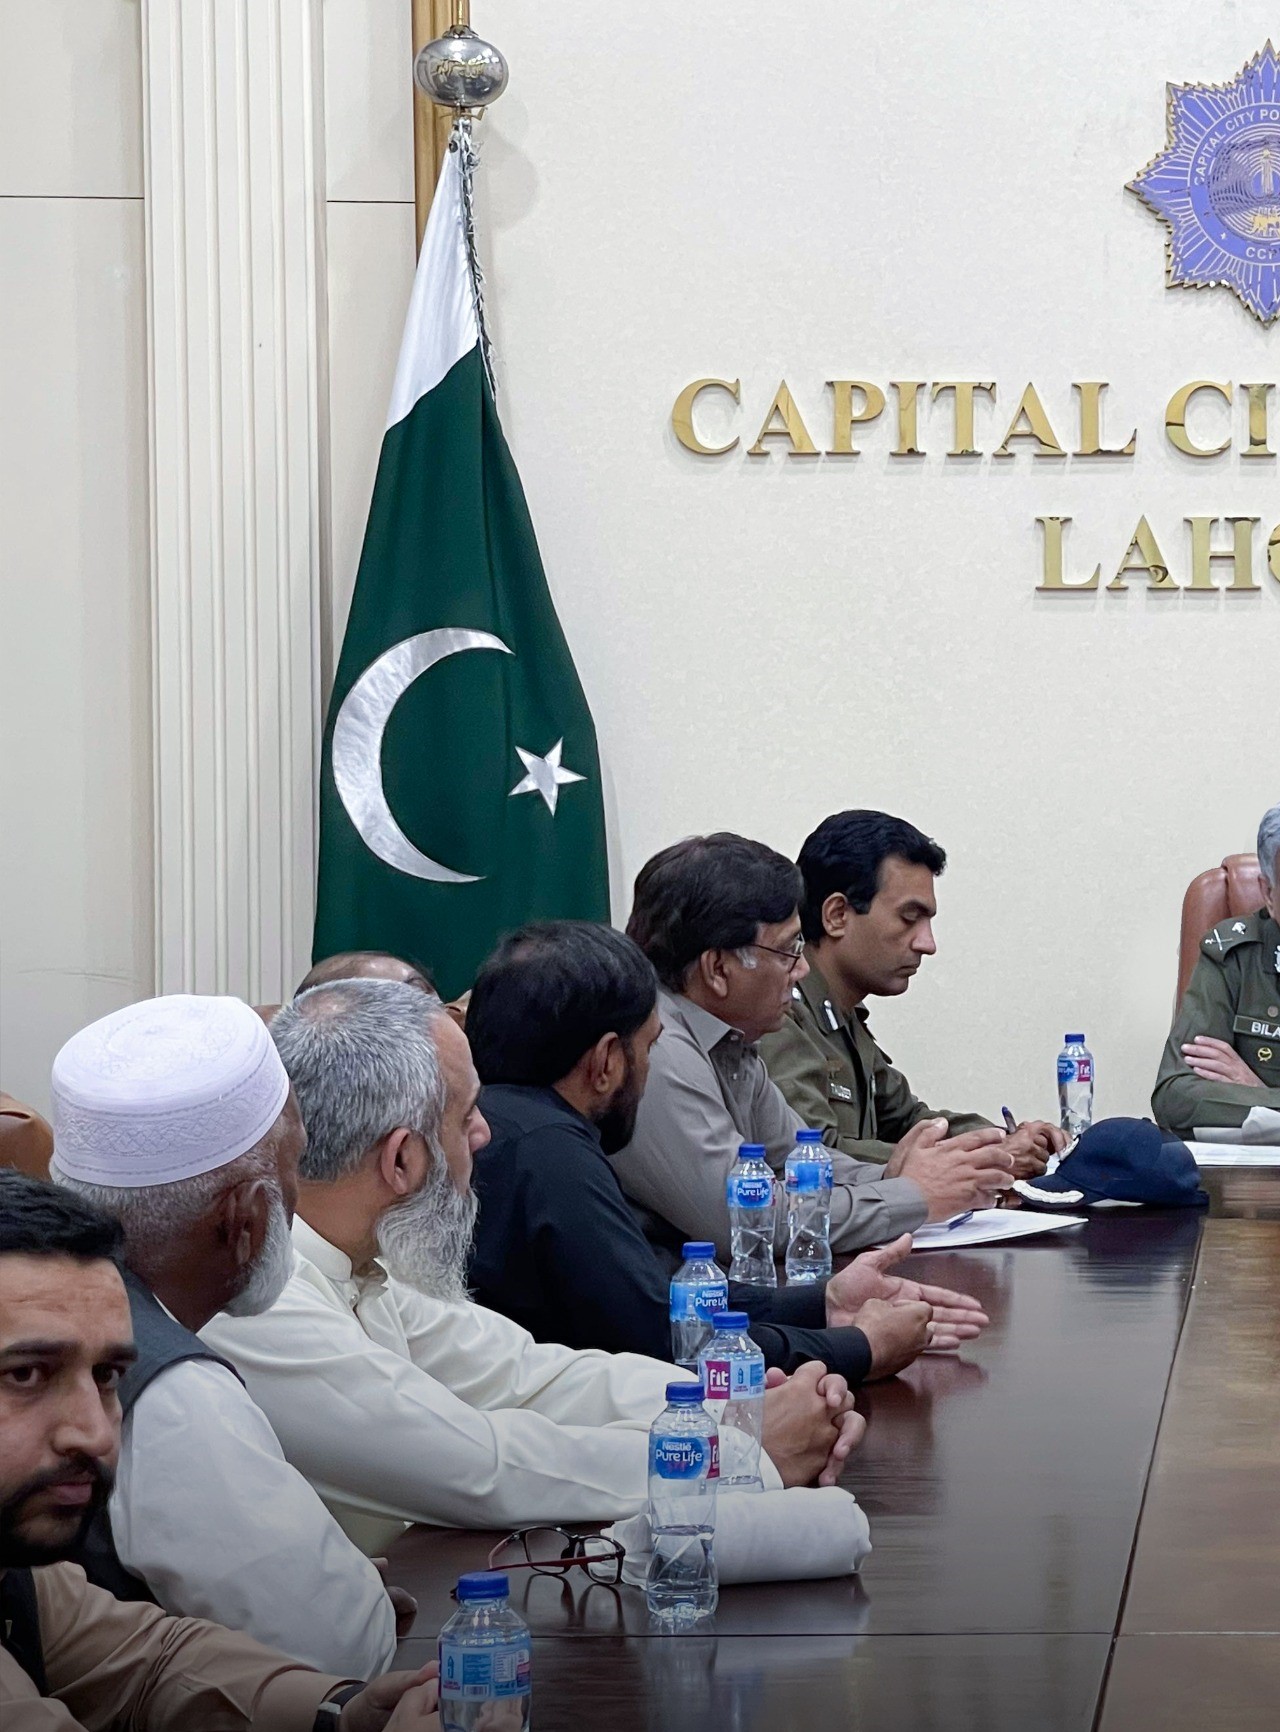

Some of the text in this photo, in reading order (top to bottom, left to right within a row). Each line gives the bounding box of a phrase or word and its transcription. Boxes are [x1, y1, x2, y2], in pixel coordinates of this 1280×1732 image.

[1194, 129, 1226, 186] CAPITAL
[1225, 110, 1255, 132] CITY
[671, 378, 1137, 456] CAPITAL
[737, 1188, 770, 1199] Pure Life
[695, 1297, 717, 1307] Pure
[710, 1368, 729, 1386] fit
[655, 1449, 703, 1466] Pure Life
